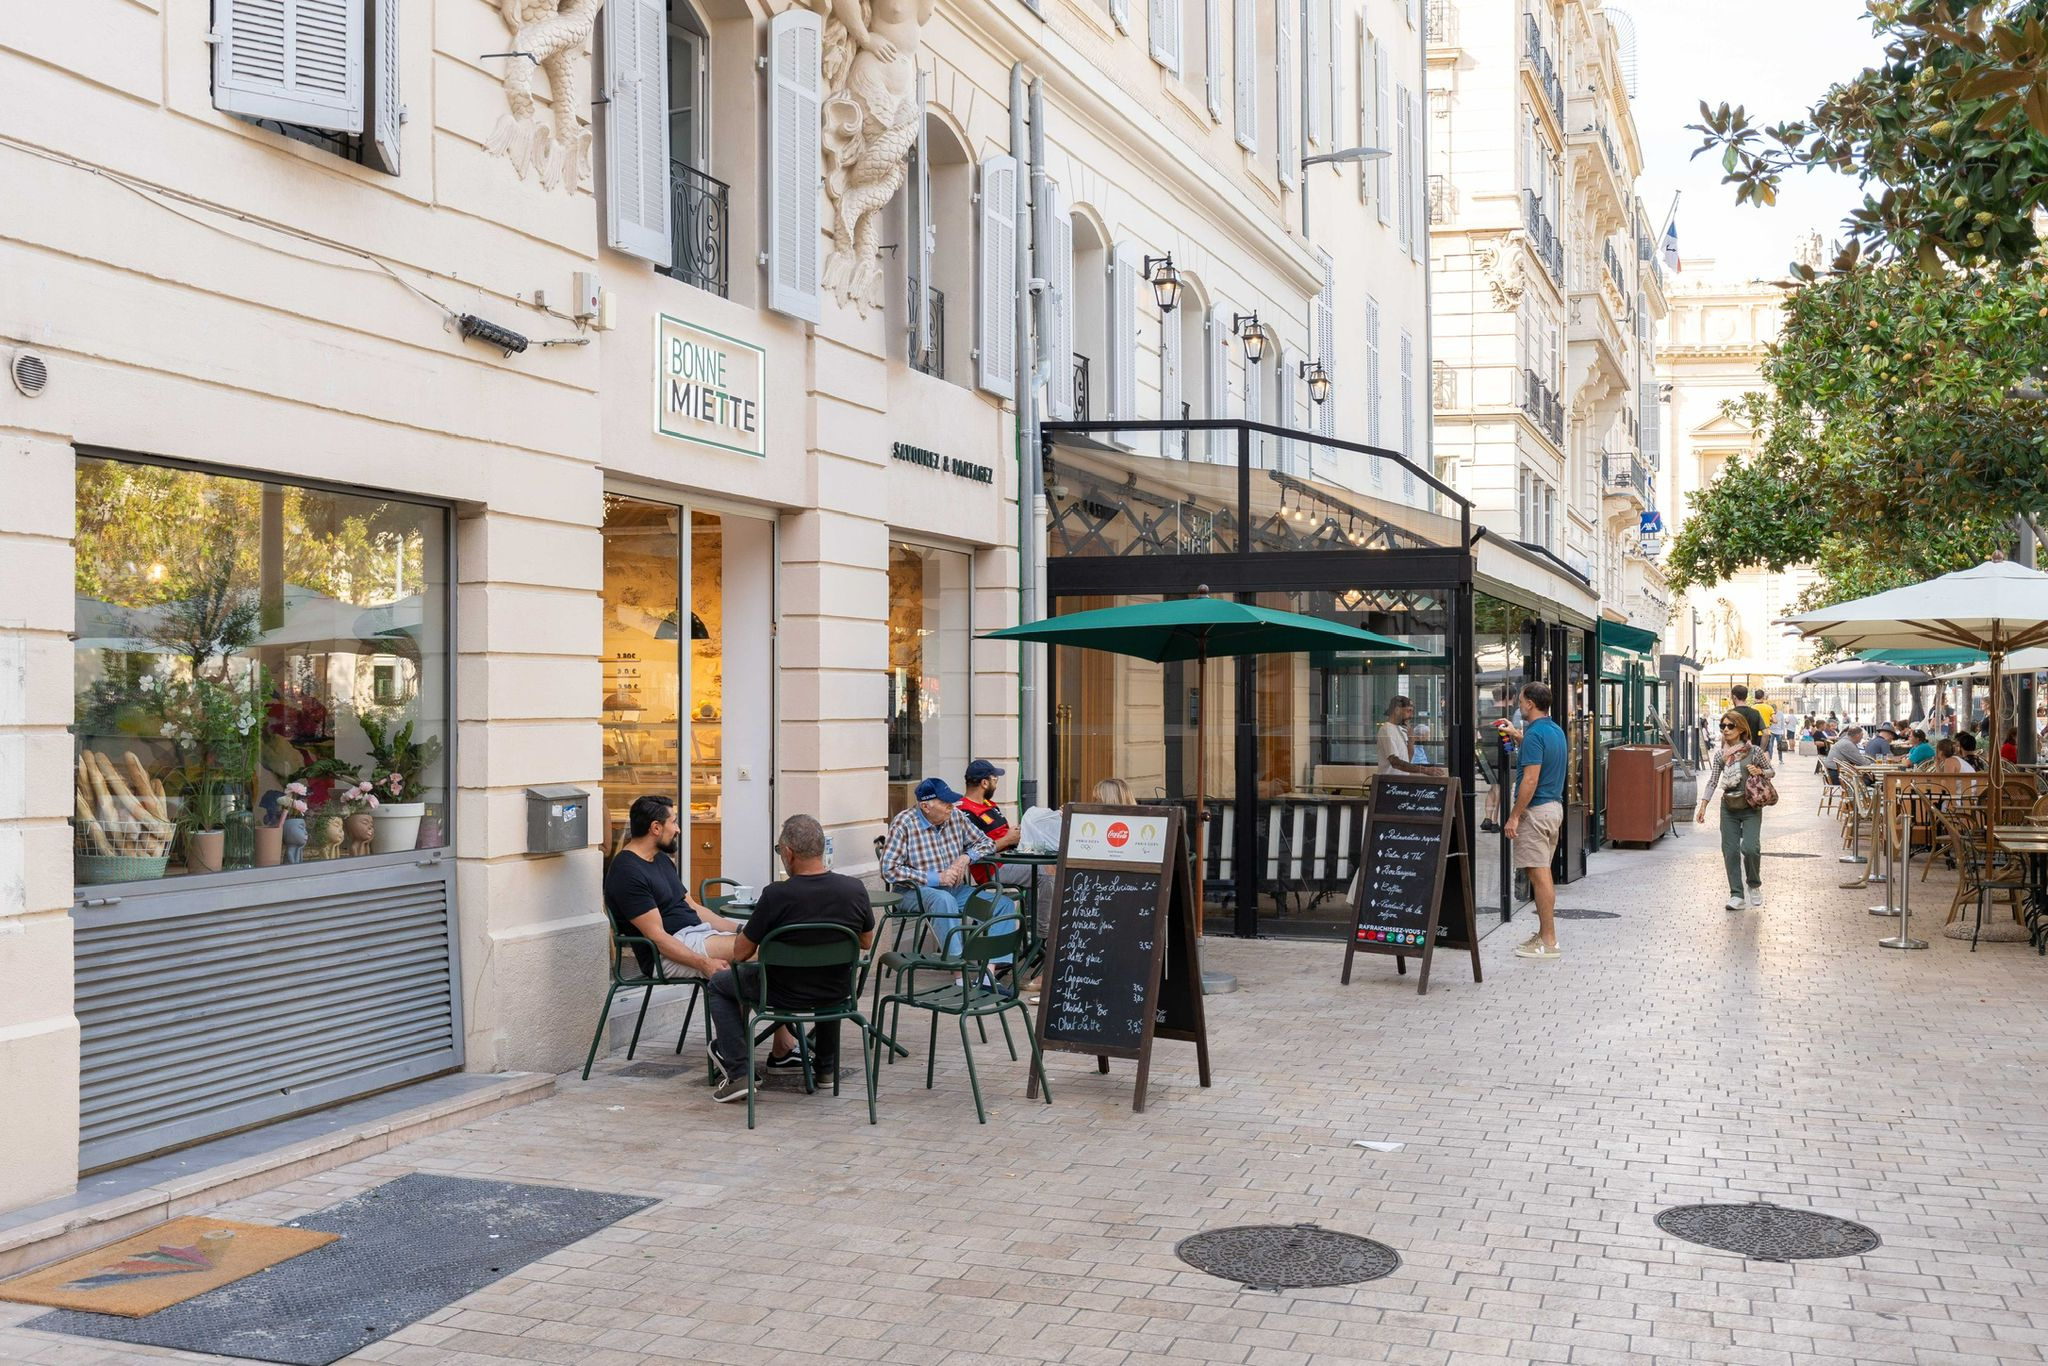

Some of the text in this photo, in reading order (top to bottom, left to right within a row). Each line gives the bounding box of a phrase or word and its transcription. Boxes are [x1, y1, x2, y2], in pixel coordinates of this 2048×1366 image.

[673, 337, 726, 388] BONNE
[672, 379, 755, 432] MIETTE
[893, 442, 993, 484] SAVOUREZ & PARTAGEZ
[1640, 522, 1658, 531] AXA
